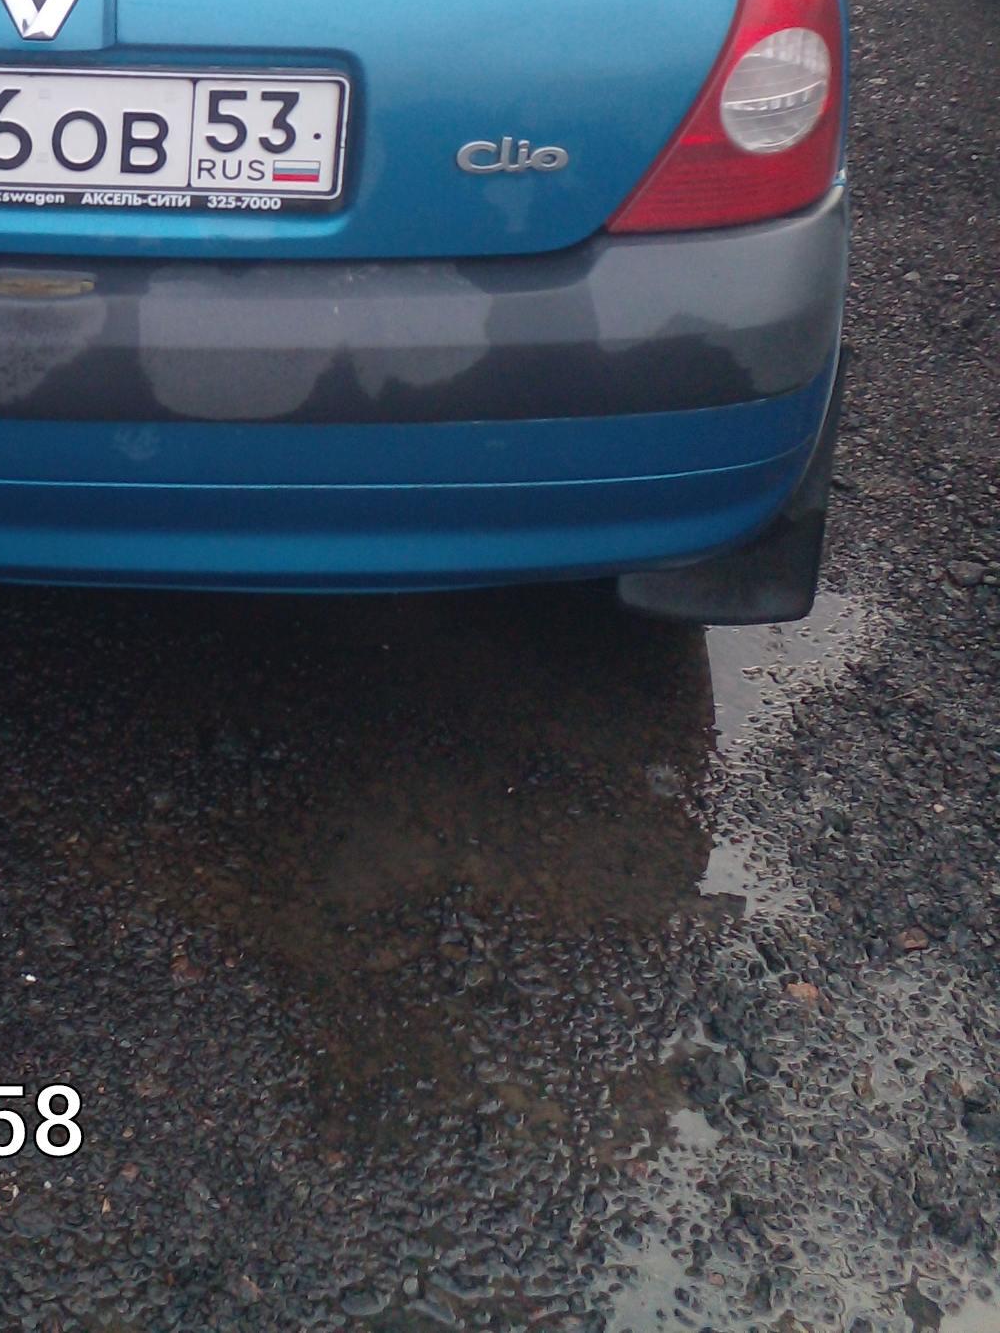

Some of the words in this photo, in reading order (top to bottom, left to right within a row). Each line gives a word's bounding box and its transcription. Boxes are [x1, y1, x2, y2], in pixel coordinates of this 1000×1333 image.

[205, 89, 301, 154] 53
[196, 158, 266, 182] RUS
[456, 136, 569, 174] Clio
[81, 192, 192, 208] АКСЕЛЬ-СИТИ
[207, 195, 282, 211] 325-7000
